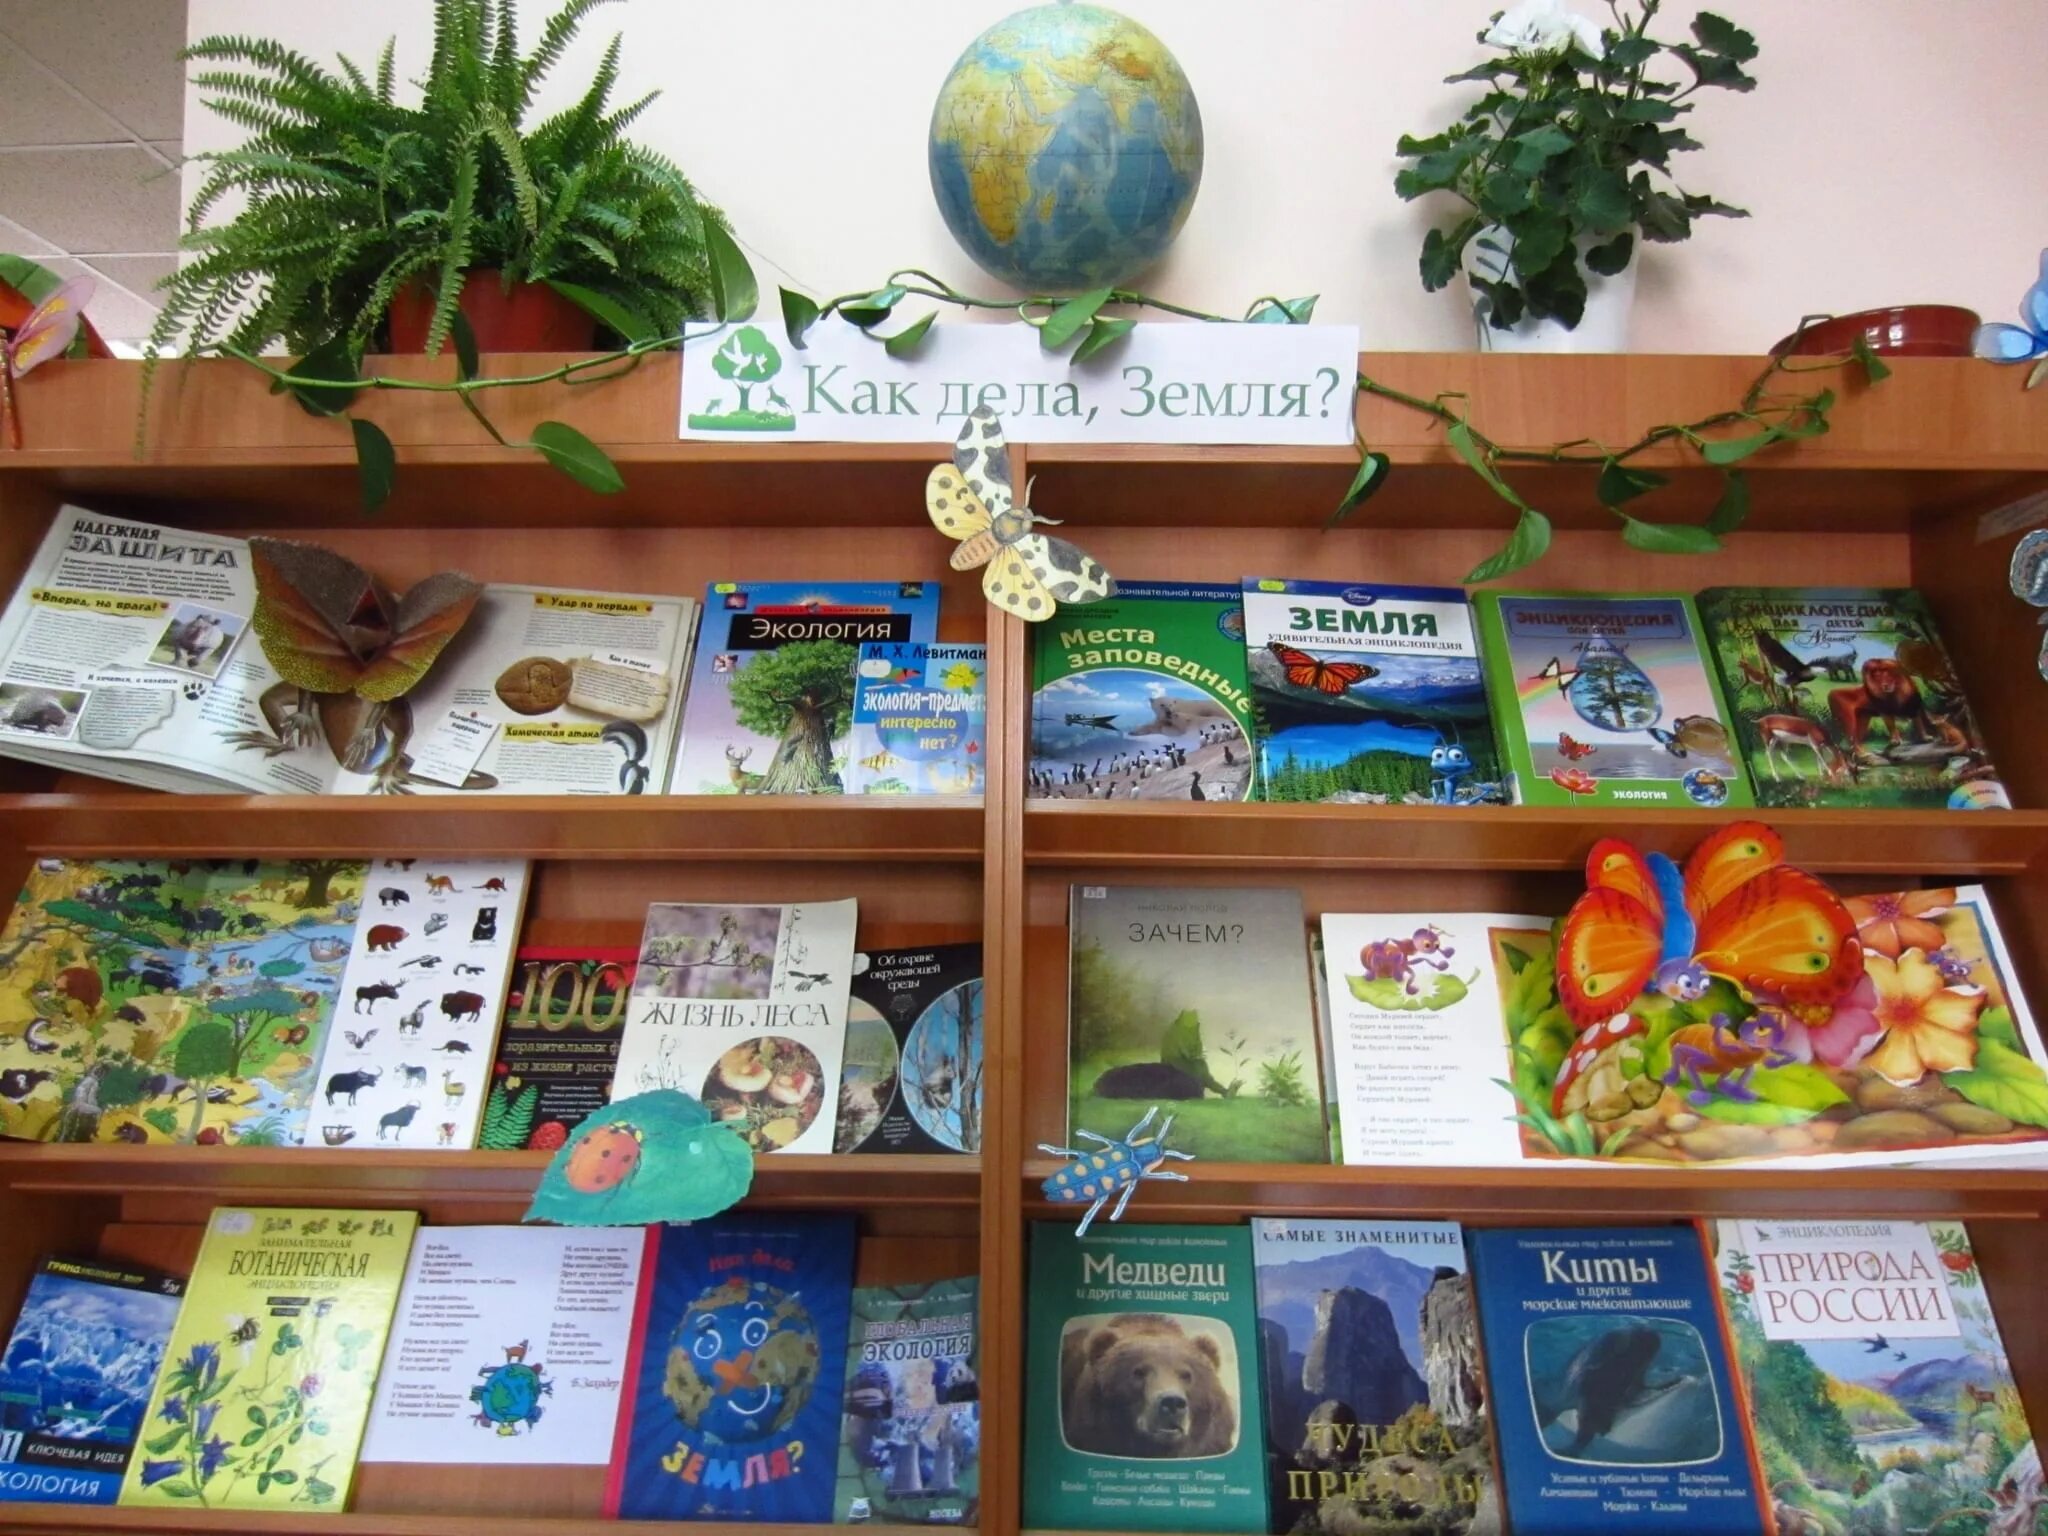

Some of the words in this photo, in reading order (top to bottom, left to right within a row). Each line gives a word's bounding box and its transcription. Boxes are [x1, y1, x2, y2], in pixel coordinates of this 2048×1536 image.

[803, 364, 921, 416] Как
[935, 382, 1099, 425] дела,
[1120, 364, 1341, 418] Земля?
[72, 520, 161, 540] НАДЕЖНАЯ
[116, 600, 158, 613] врага!
[551, 596, 577, 609] Удар
[580, 600, 593, 608] по
[596, 601, 638, 612] нервам
[750, 618, 892, 639] Экология
[1288, 606, 1439, 638] ЗЕМЛЯ
[1515, 611, 1675, 626] ЭНЦИКЛОПЕДИЯ
[1060, 627, 1155, 649] Места
[1267, 632, 1363, 646] УДИВИТЕЛЬНАЯ
[1364, 638, 1463, 651] ЭНЦИКЛОПЕДИЯ
[869, 645, 887, 659] М.
[894, 645, 908, 659] Х.
[913, 645, 986, 660] Левитман
[1067, 647, 1252, 714] заповедные
[505, 726, 565, 738] Химическая
[567, 730, 600, 738] атака
[880, 717, 957, 732] интересно
[1128, 922, 1245, 944] ЗАЧЕМ?
[878, 954, 896, 967] Об
[898, 952, 935, 968] охране
[870, 964, 941, 982] окружающей
[509, 961, 627, 1033] 100
[640, 1002, 744, 1028] ЖИЗНЬ
[750, 1002, 832, 1027] ЛЕСА
[1263, 1229, 1326, 1243] САМЫЕ
[1335, 1230, 1459, 1245] ЗНАМЕНИТЫЕ
[1777, 1224, 1893, 1239] ЭНЦИКЛОПЕДИЯ
[228, 1250, 371, 1278] БОТАНИЧЕСКАЯ
[1082, 1252, 1226, 1287] Медведи
[1541, 1250, 1659, 1284] Киты
[1756, 1249, 1936, 1283] ПРИРОДА
[1087, 1288, 1132, 1301] другие
[1136, 1289, 1189, 1302] хищные
[1192, 1290, 1230, 1304] звери
[1576, 1287, 1584, 1296] и
[1588, 1286, 1633, 1299] другие
[1522, 1299, 1578, 1312] морские
[1580, 1299, 1692, 1310] млекопитающие
[1765, 1287, 1948, 1324] РОССИИ
[863, 1332, 973, 1362] ЭКОЛОГИЯ
[1305, 1423, 1457, 1458] ЧУДЕСА
[27, 1443, 92, 1460] КЛЮЧЕВАЯ
[94, 1451, 126, 1464] ИДЕЯ
[1287, 1470, 1485, 1502] ПРИРОДЫ
